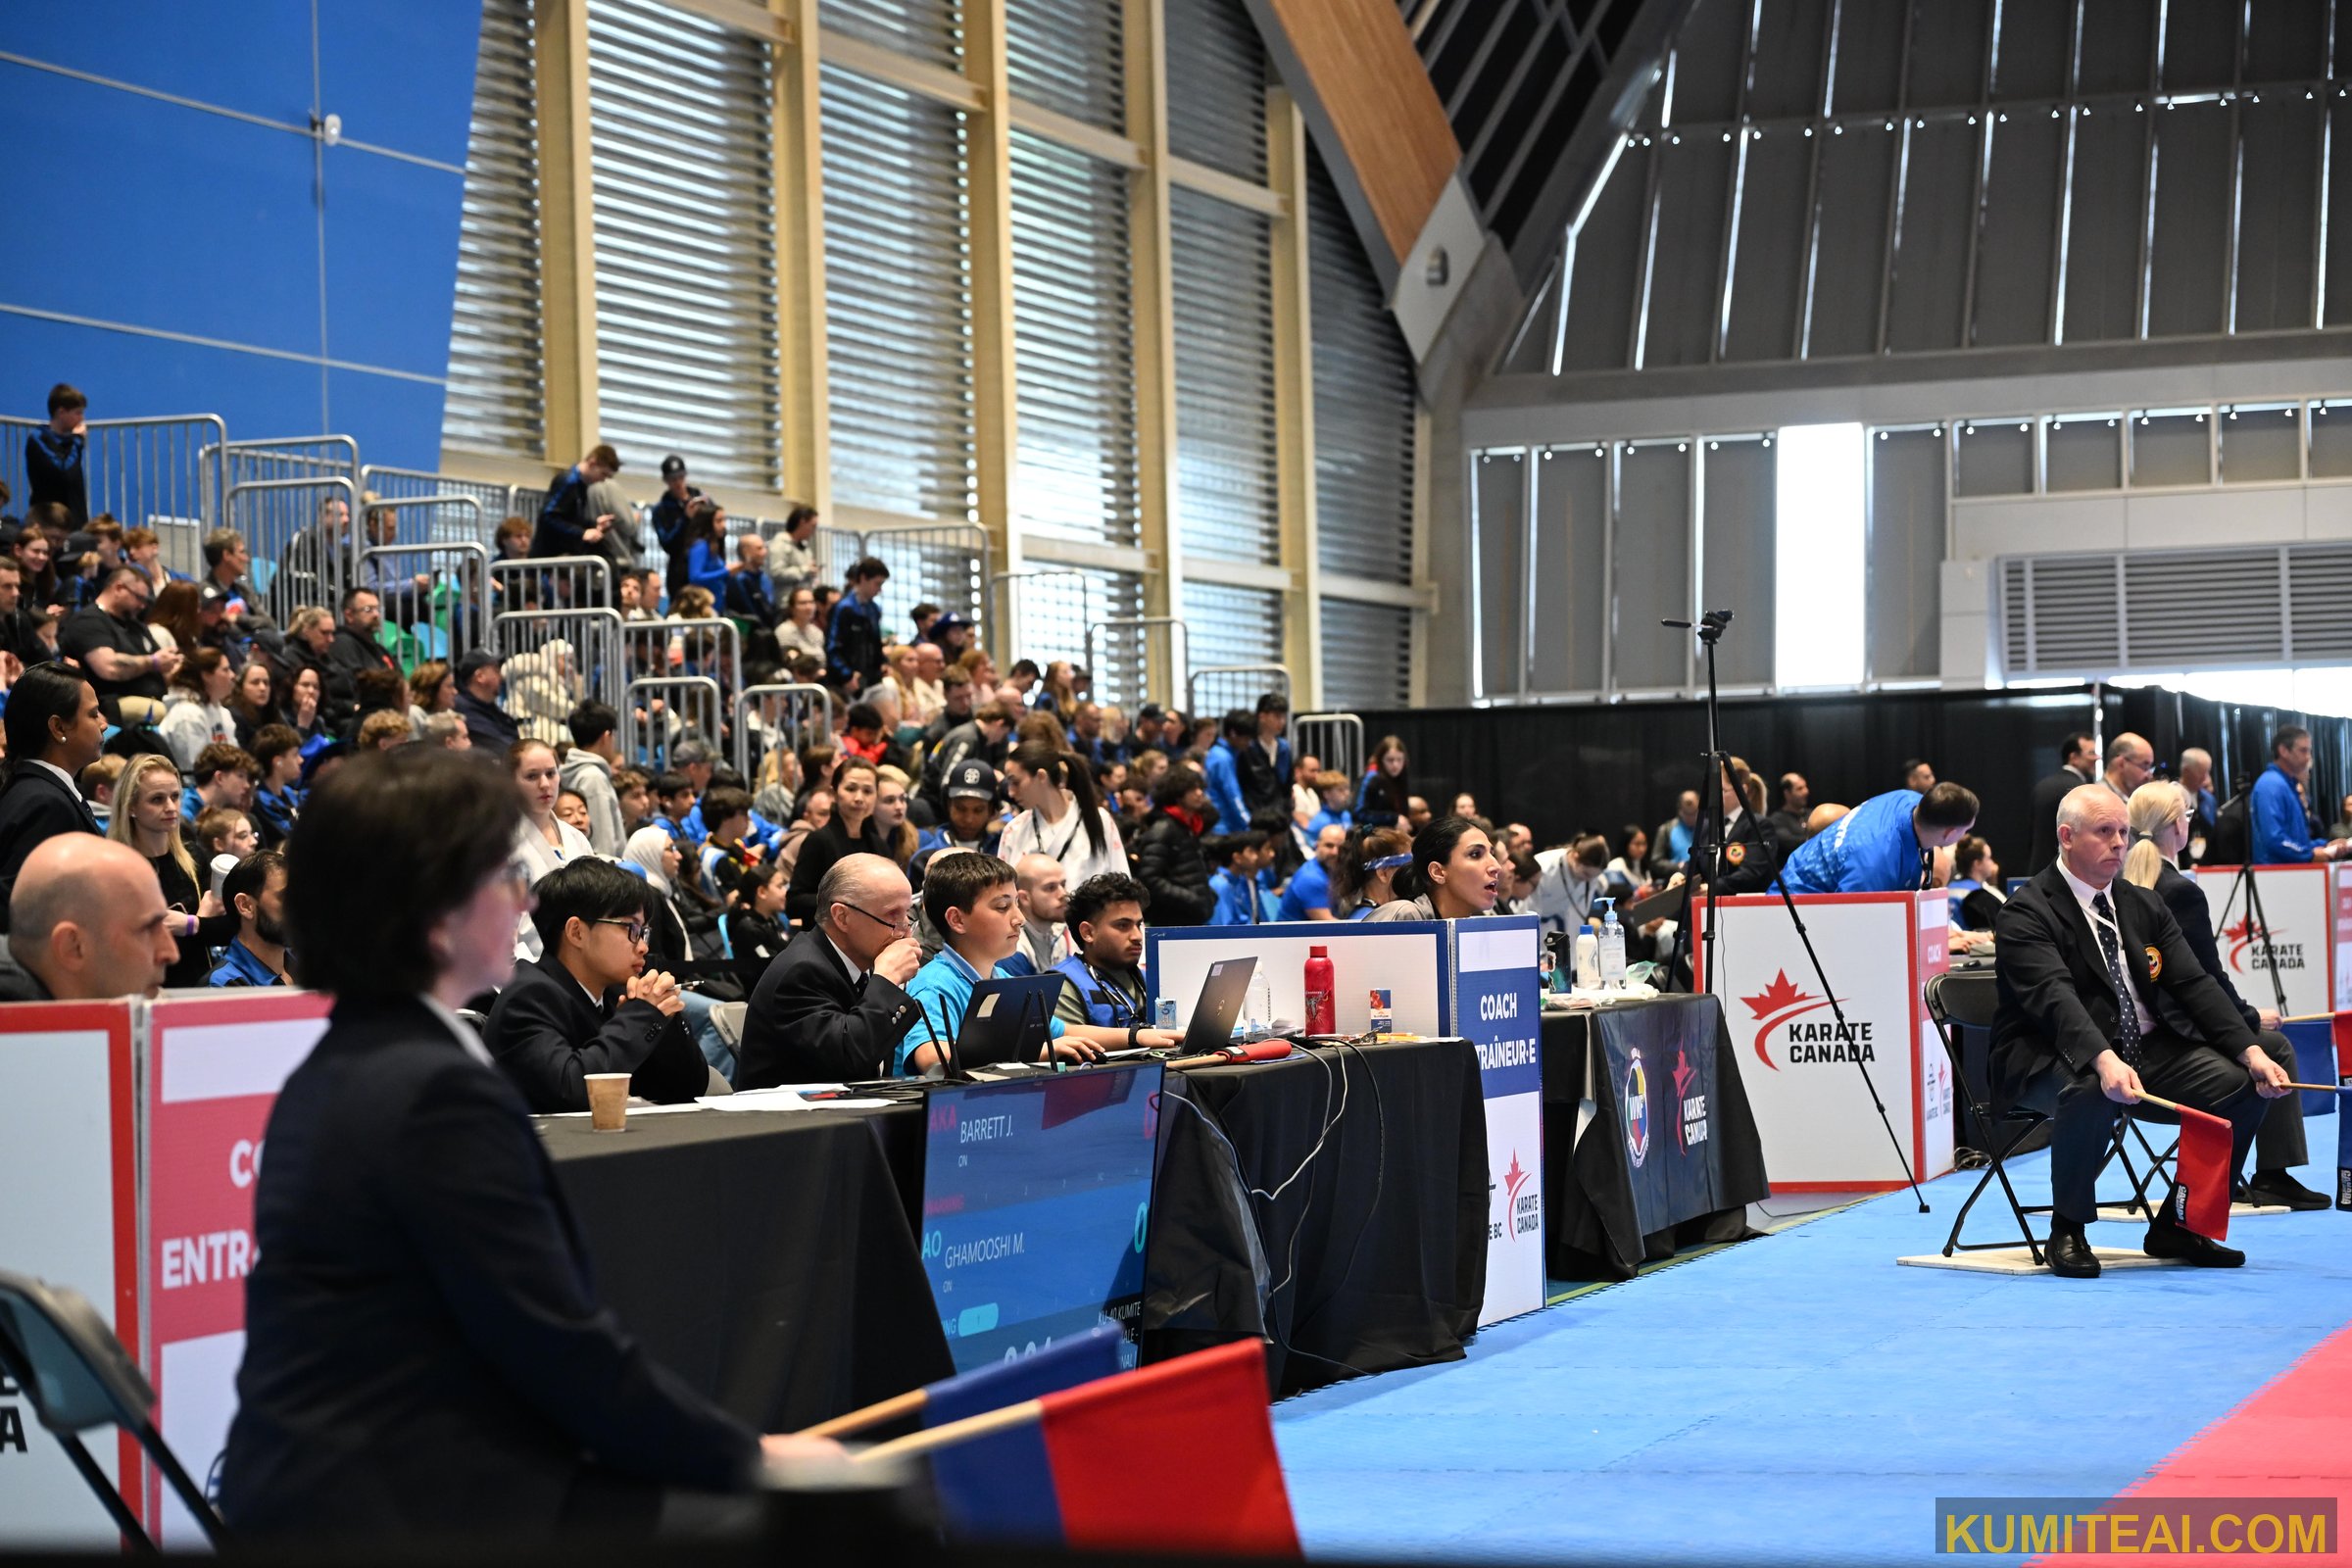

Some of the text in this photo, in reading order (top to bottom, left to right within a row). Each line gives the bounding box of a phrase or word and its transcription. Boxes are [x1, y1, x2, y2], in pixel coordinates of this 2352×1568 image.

[1480, 992, 1517, 1021] COACH
[1789, 1022, 1873, 1043] KARATE
[959, 1114, 1013, 1144] BARRETT J.
[1516, 1195, 1538, 1215] KARATE
[1134, 1201, 1148, 1253] 0
[1494, 1222, 1502, 1239] BC
[1517, 1214, 1539, 1234] CANADA
[921, 1230, 942, 1259] AO
[945, 1232, 1025, 1269] GHAMOOSHI M.
[1117, 1301, 1141, 1321] KUMITE
